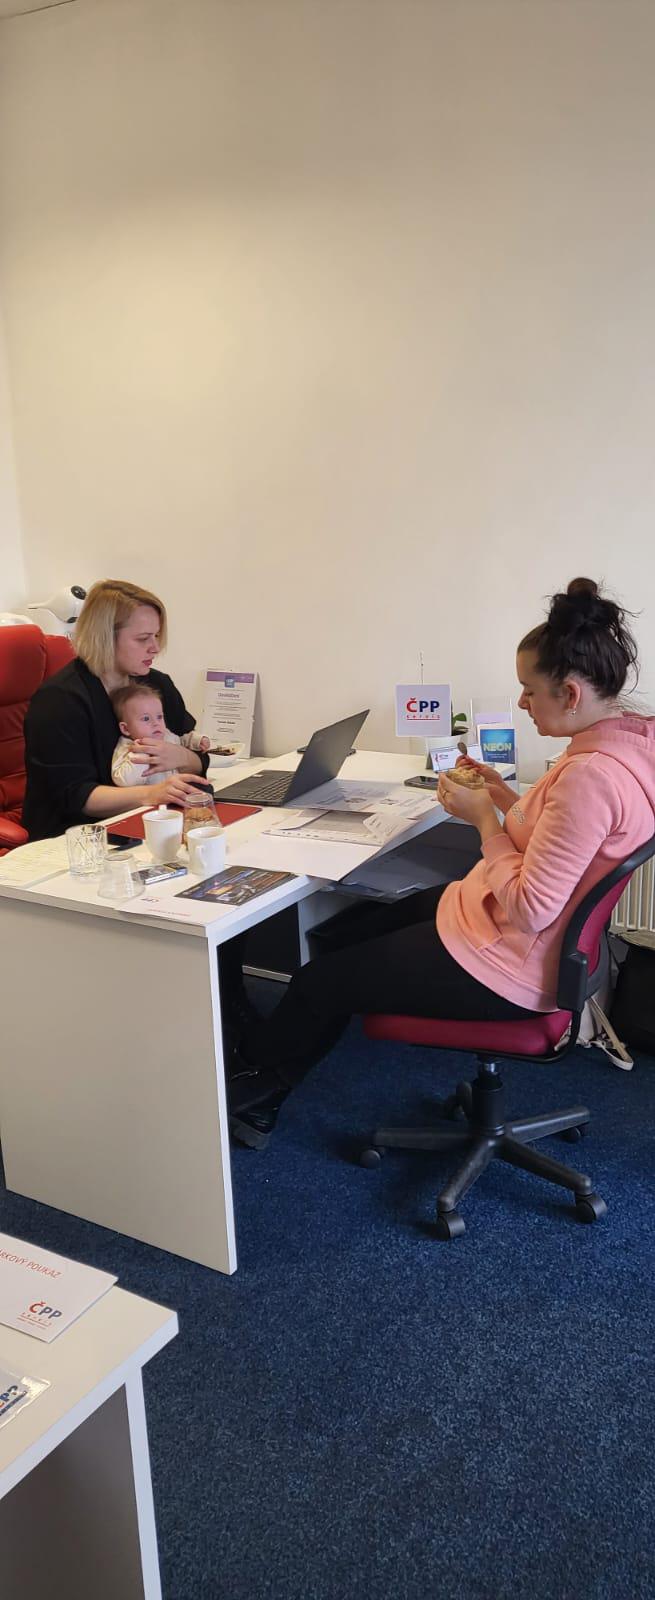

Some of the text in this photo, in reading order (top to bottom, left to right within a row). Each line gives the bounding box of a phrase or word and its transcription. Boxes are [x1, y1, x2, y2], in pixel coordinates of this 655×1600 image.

[406, 697, 440, 712] ČPP
[483, 742, 512, 751] NEON
[26, 1261, 62, 1278] POUKAZ
[29, 1301, 62, 1319] ČPP
